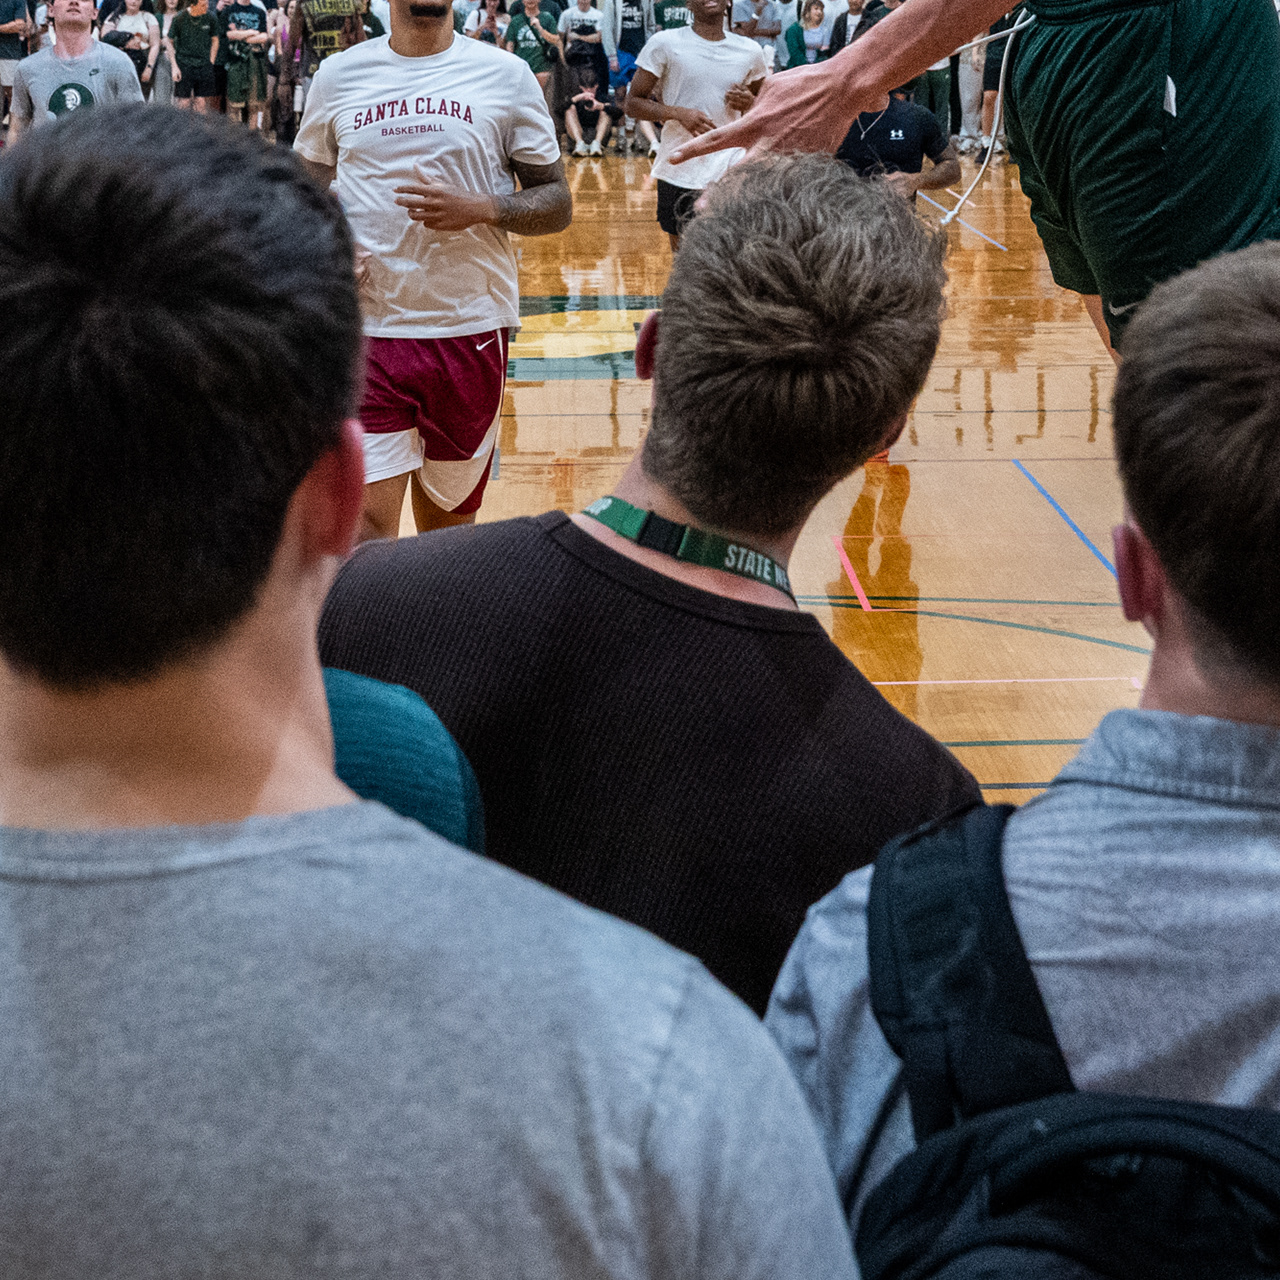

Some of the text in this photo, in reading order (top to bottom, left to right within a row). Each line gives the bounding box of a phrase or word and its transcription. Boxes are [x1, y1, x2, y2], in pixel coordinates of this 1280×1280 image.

[353, 97, 474, 131] SANTA CLARA
[381, 123, 445, 137] BASKETBALL
[724, 544, 772, 581] STATE
